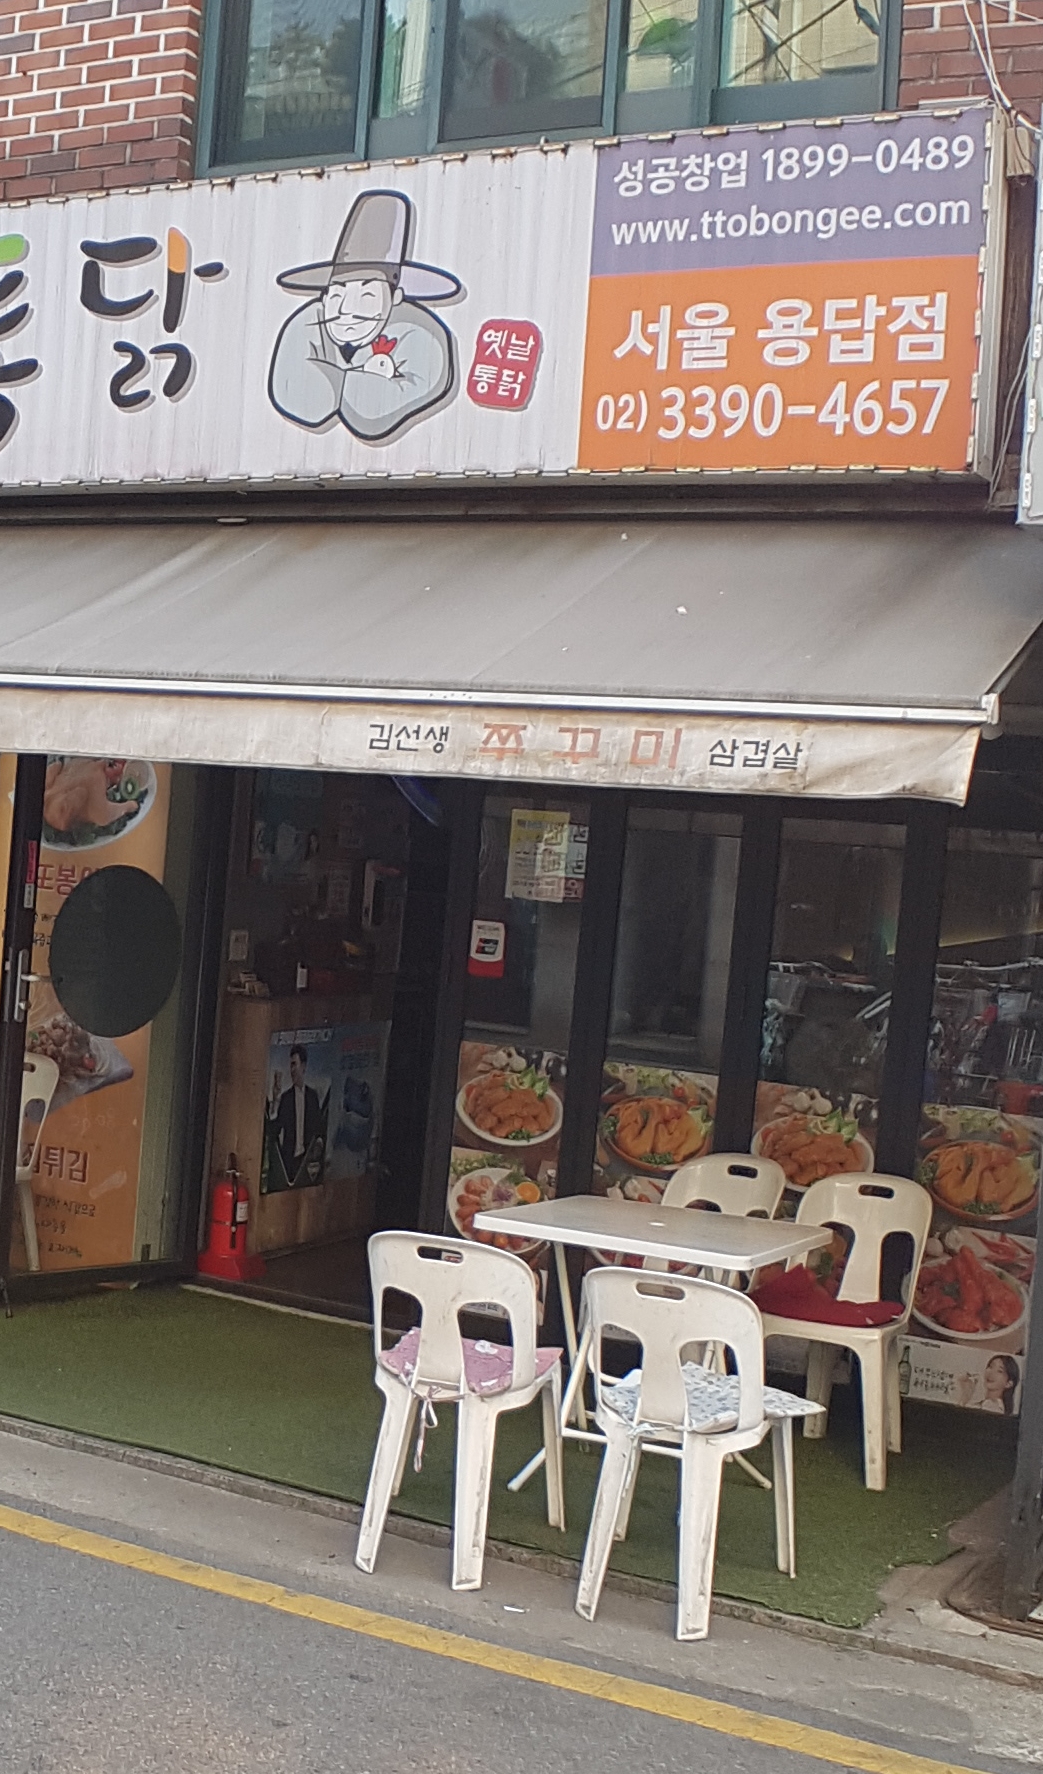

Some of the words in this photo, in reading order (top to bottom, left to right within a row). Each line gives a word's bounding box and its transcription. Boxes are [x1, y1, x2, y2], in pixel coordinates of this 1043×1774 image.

[613, 149, 749, 198] 성공창업
[761, 134, 975, 183] 1899-0489
[612, 199, 971, 246] www.ttobongee.com
[481, 328, 535, 362] 옛날
[613, 302, 736, 371] 서울
[757, 291, 949, 368] 용답점
[472, 364, 526, 402] 통닭
[368, 723, 451, 754] 김선생
[708, 737, 804, 771] 삼겹살
